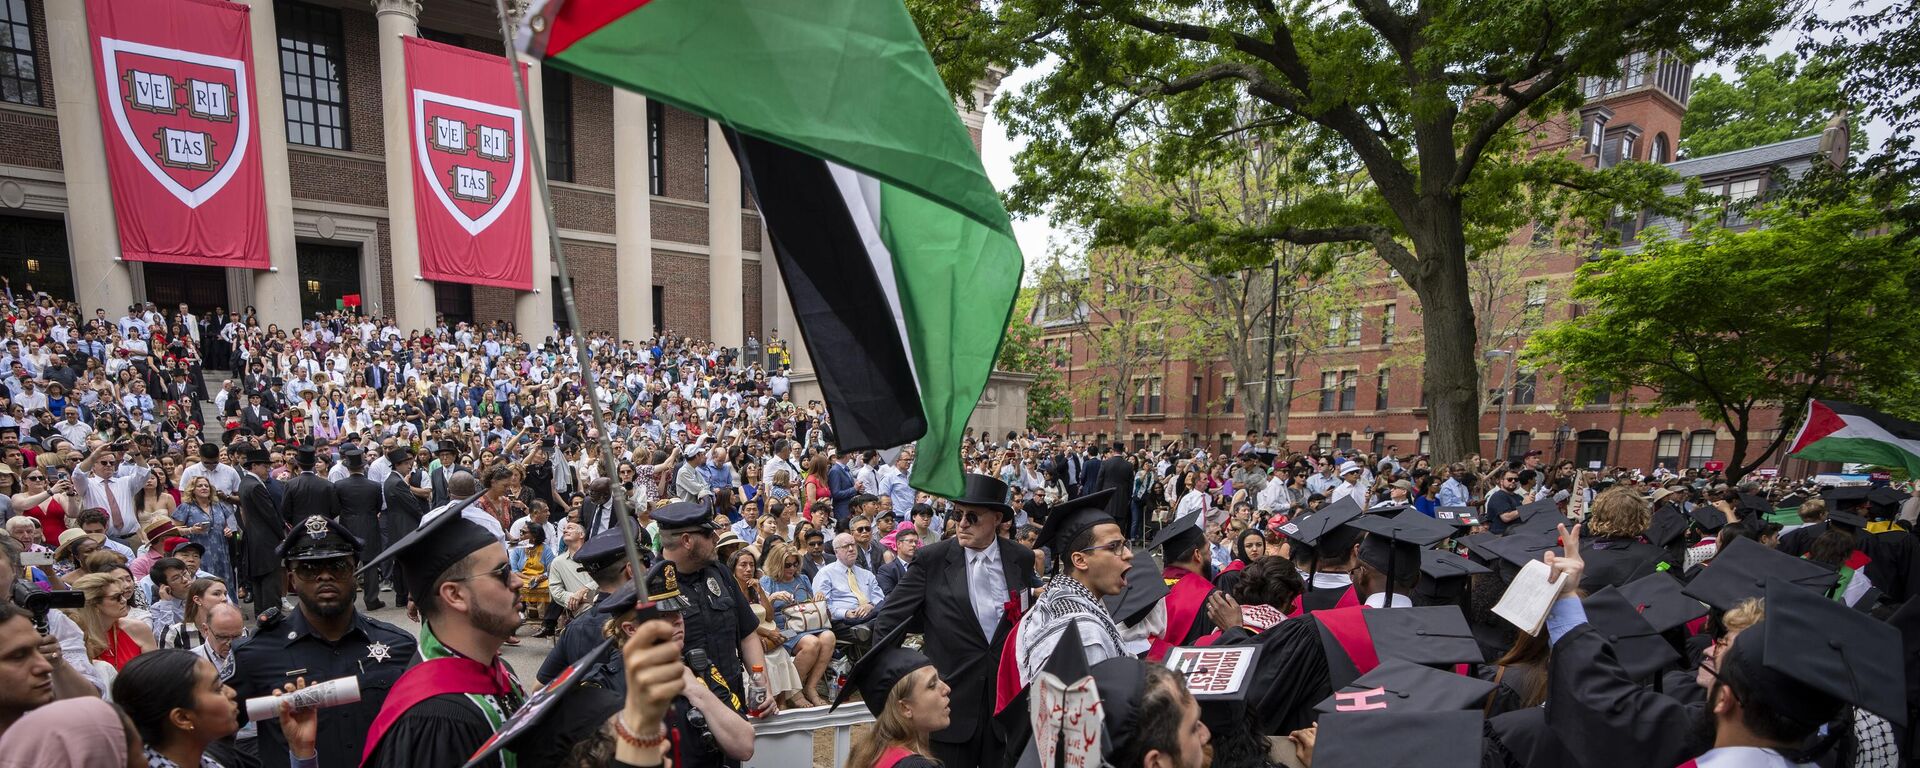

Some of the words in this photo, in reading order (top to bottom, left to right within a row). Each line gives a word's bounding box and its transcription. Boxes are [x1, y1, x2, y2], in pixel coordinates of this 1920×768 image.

[137, 81, 164, 100] VE
[196, 90, 219, 108] RI
[439, 126, 459, 142] VE
[484, 134, 499, 150] RI
[171, 137, 203, 156] TAS
[461, 174, 485, 190] TAS
[1573, 498, 1583, 516] ALL
[1210, 651, 1242, 691] HARVARD
[1335, 686, 1387, 712] H
[1050, 747, 1084, 768] PSTINE
